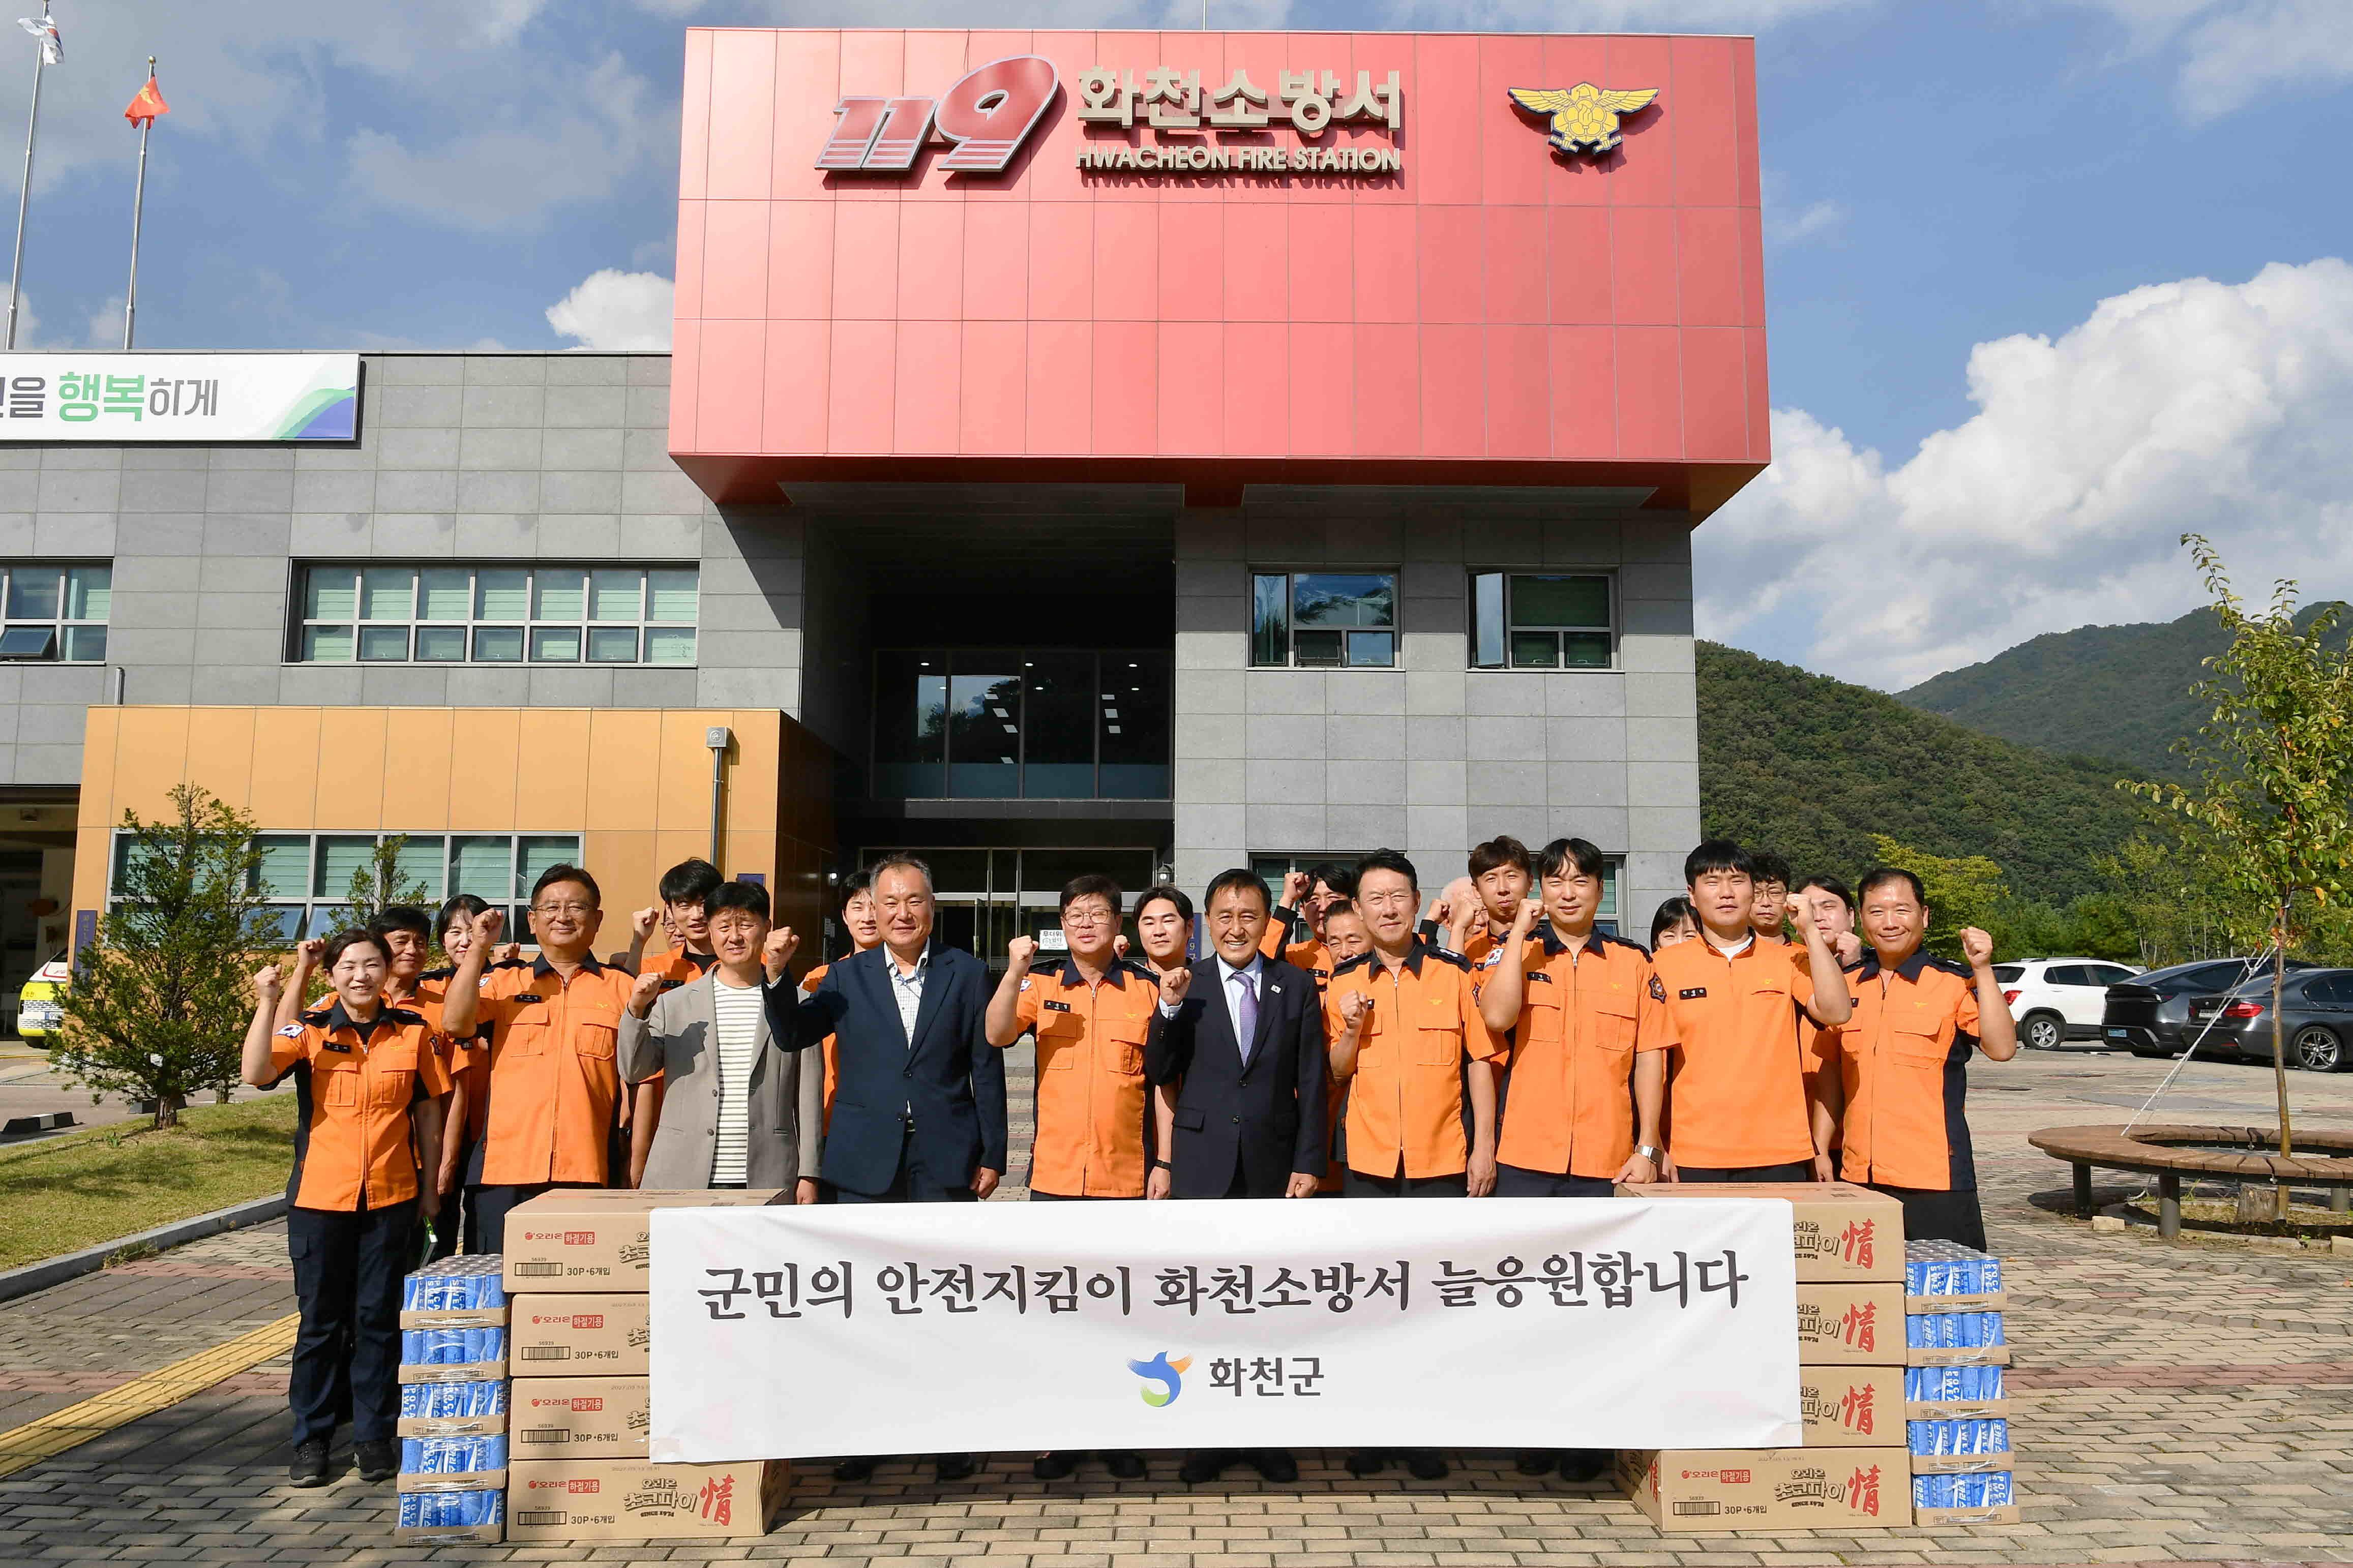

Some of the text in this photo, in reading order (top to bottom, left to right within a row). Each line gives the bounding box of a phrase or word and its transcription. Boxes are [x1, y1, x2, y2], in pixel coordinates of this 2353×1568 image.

[1078, 66, 1400, 132] 화천소방서
[814, 54, 1059, 171] 119
[1075, 145, 1400, 170] HWACHEON FIRE STATION
[0, 372, 218, 421] 을 행복하게
[565, 1232, 594, 1245] 하절기용
[1794, 1221, 1820, 1232] 리온
[1841, 1218, 1875, 1269] 情
[698, 1250, 1749, 1319] 군민의 안전지킴이 화천소방서 늘응원합니다
[573, 1316, 603, 1328] 하절기용
[1842, 1301, 1877, 1352] 情
[1210, 1357, 1324, 1397] 화천군
[573, 1399, 602, 1411] 하절기용
[1801, 1398, 1840, 1422] 파이
[1842, 1383, 1875, 1435] 情
[569, 1480, 599, 1492] 하절기용
[642, 1477, 678, 1490] 오리온
[1722, 1470, 1749, 1482] 하절기용
[1791, 1468, 1825, 1480] 오리온
[623, 1490, 698, 1512] 초코파이
[700, 1473, 735, 1526] 情
[1774, 1481, 1846, 1503] 초코파이
[1848, 1464, 1881, 1516] 情
